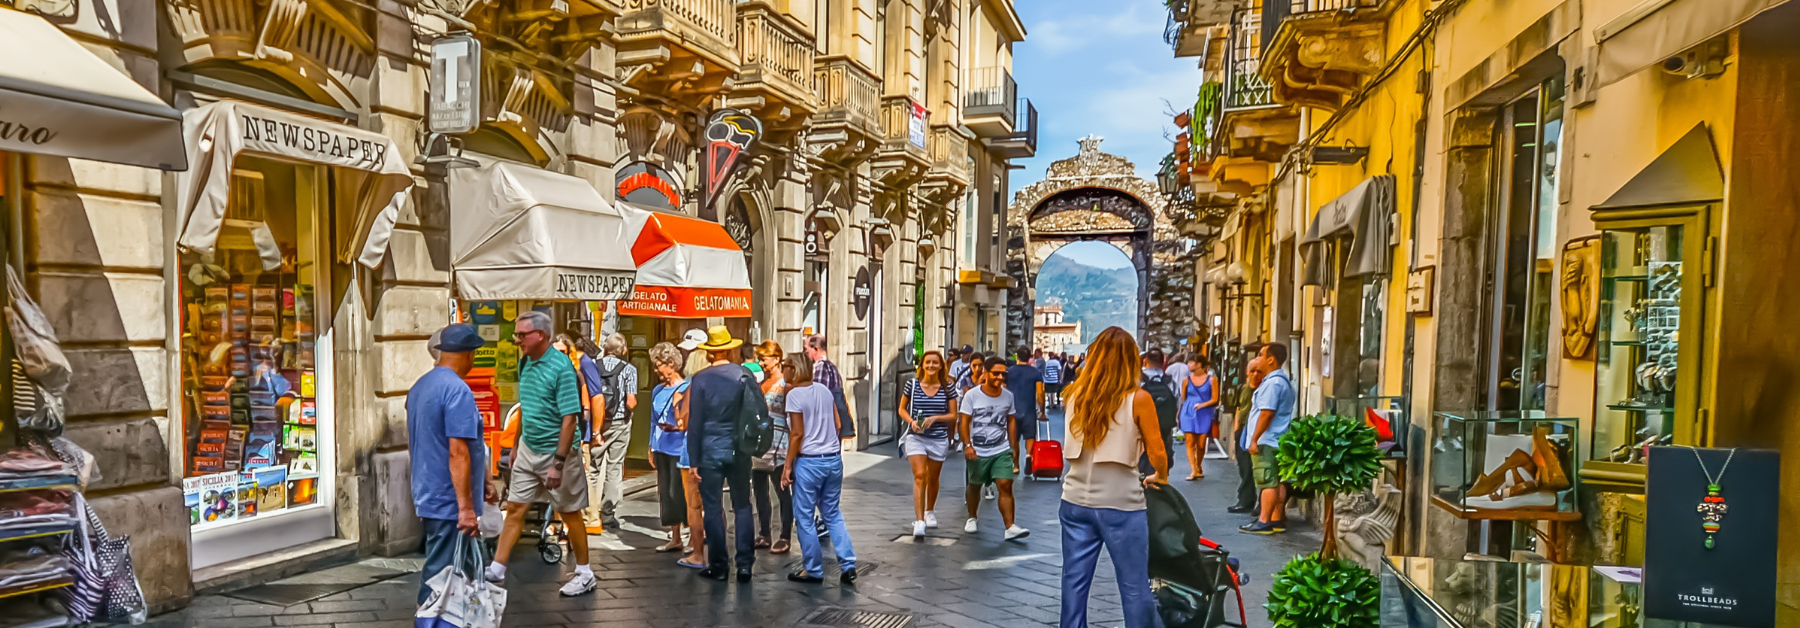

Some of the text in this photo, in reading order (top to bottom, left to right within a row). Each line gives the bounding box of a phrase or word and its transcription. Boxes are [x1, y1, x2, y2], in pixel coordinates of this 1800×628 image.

[436, 41, 468, 104] T
[433, 101, 471, 110] TABACCHI
[242, 115, 386, 166] NEWSPAPER
[634, 291, 667, 301] GELATO
[694, 294, 749, 310] GELATOMANIA
[622, 301, 678, 312] ARTIGIANALE
[202, 476, 224, 486] SICILIA
[225, 473, 237, 483] 2017
[1677, 594, 1738, 606] TROLLBEADS
